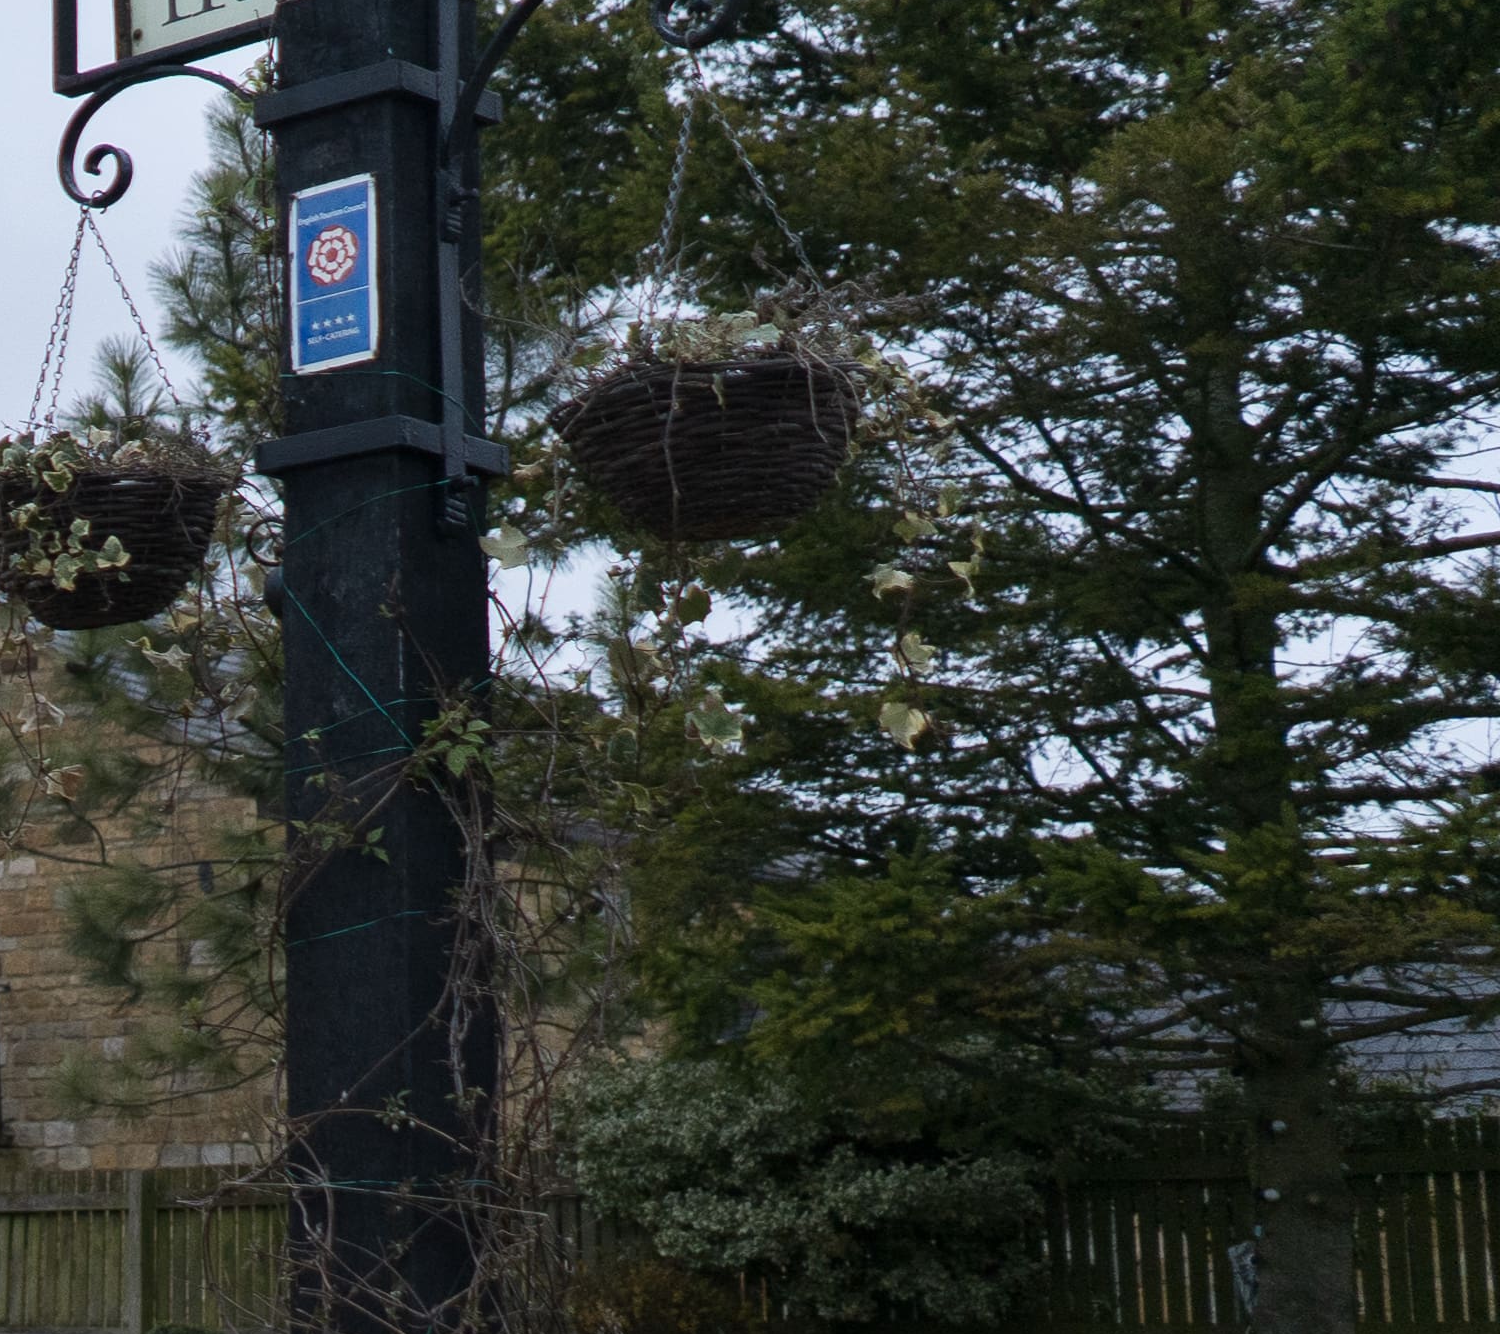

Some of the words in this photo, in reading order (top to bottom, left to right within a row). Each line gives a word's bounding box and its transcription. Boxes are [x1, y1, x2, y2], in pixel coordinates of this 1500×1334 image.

[298, 213, 320, 226] English
[320, 208, 343, 220] Tourism
[343, 201, 366, 214] Council
[307, 327, 360, 345] SELF-CATERING
